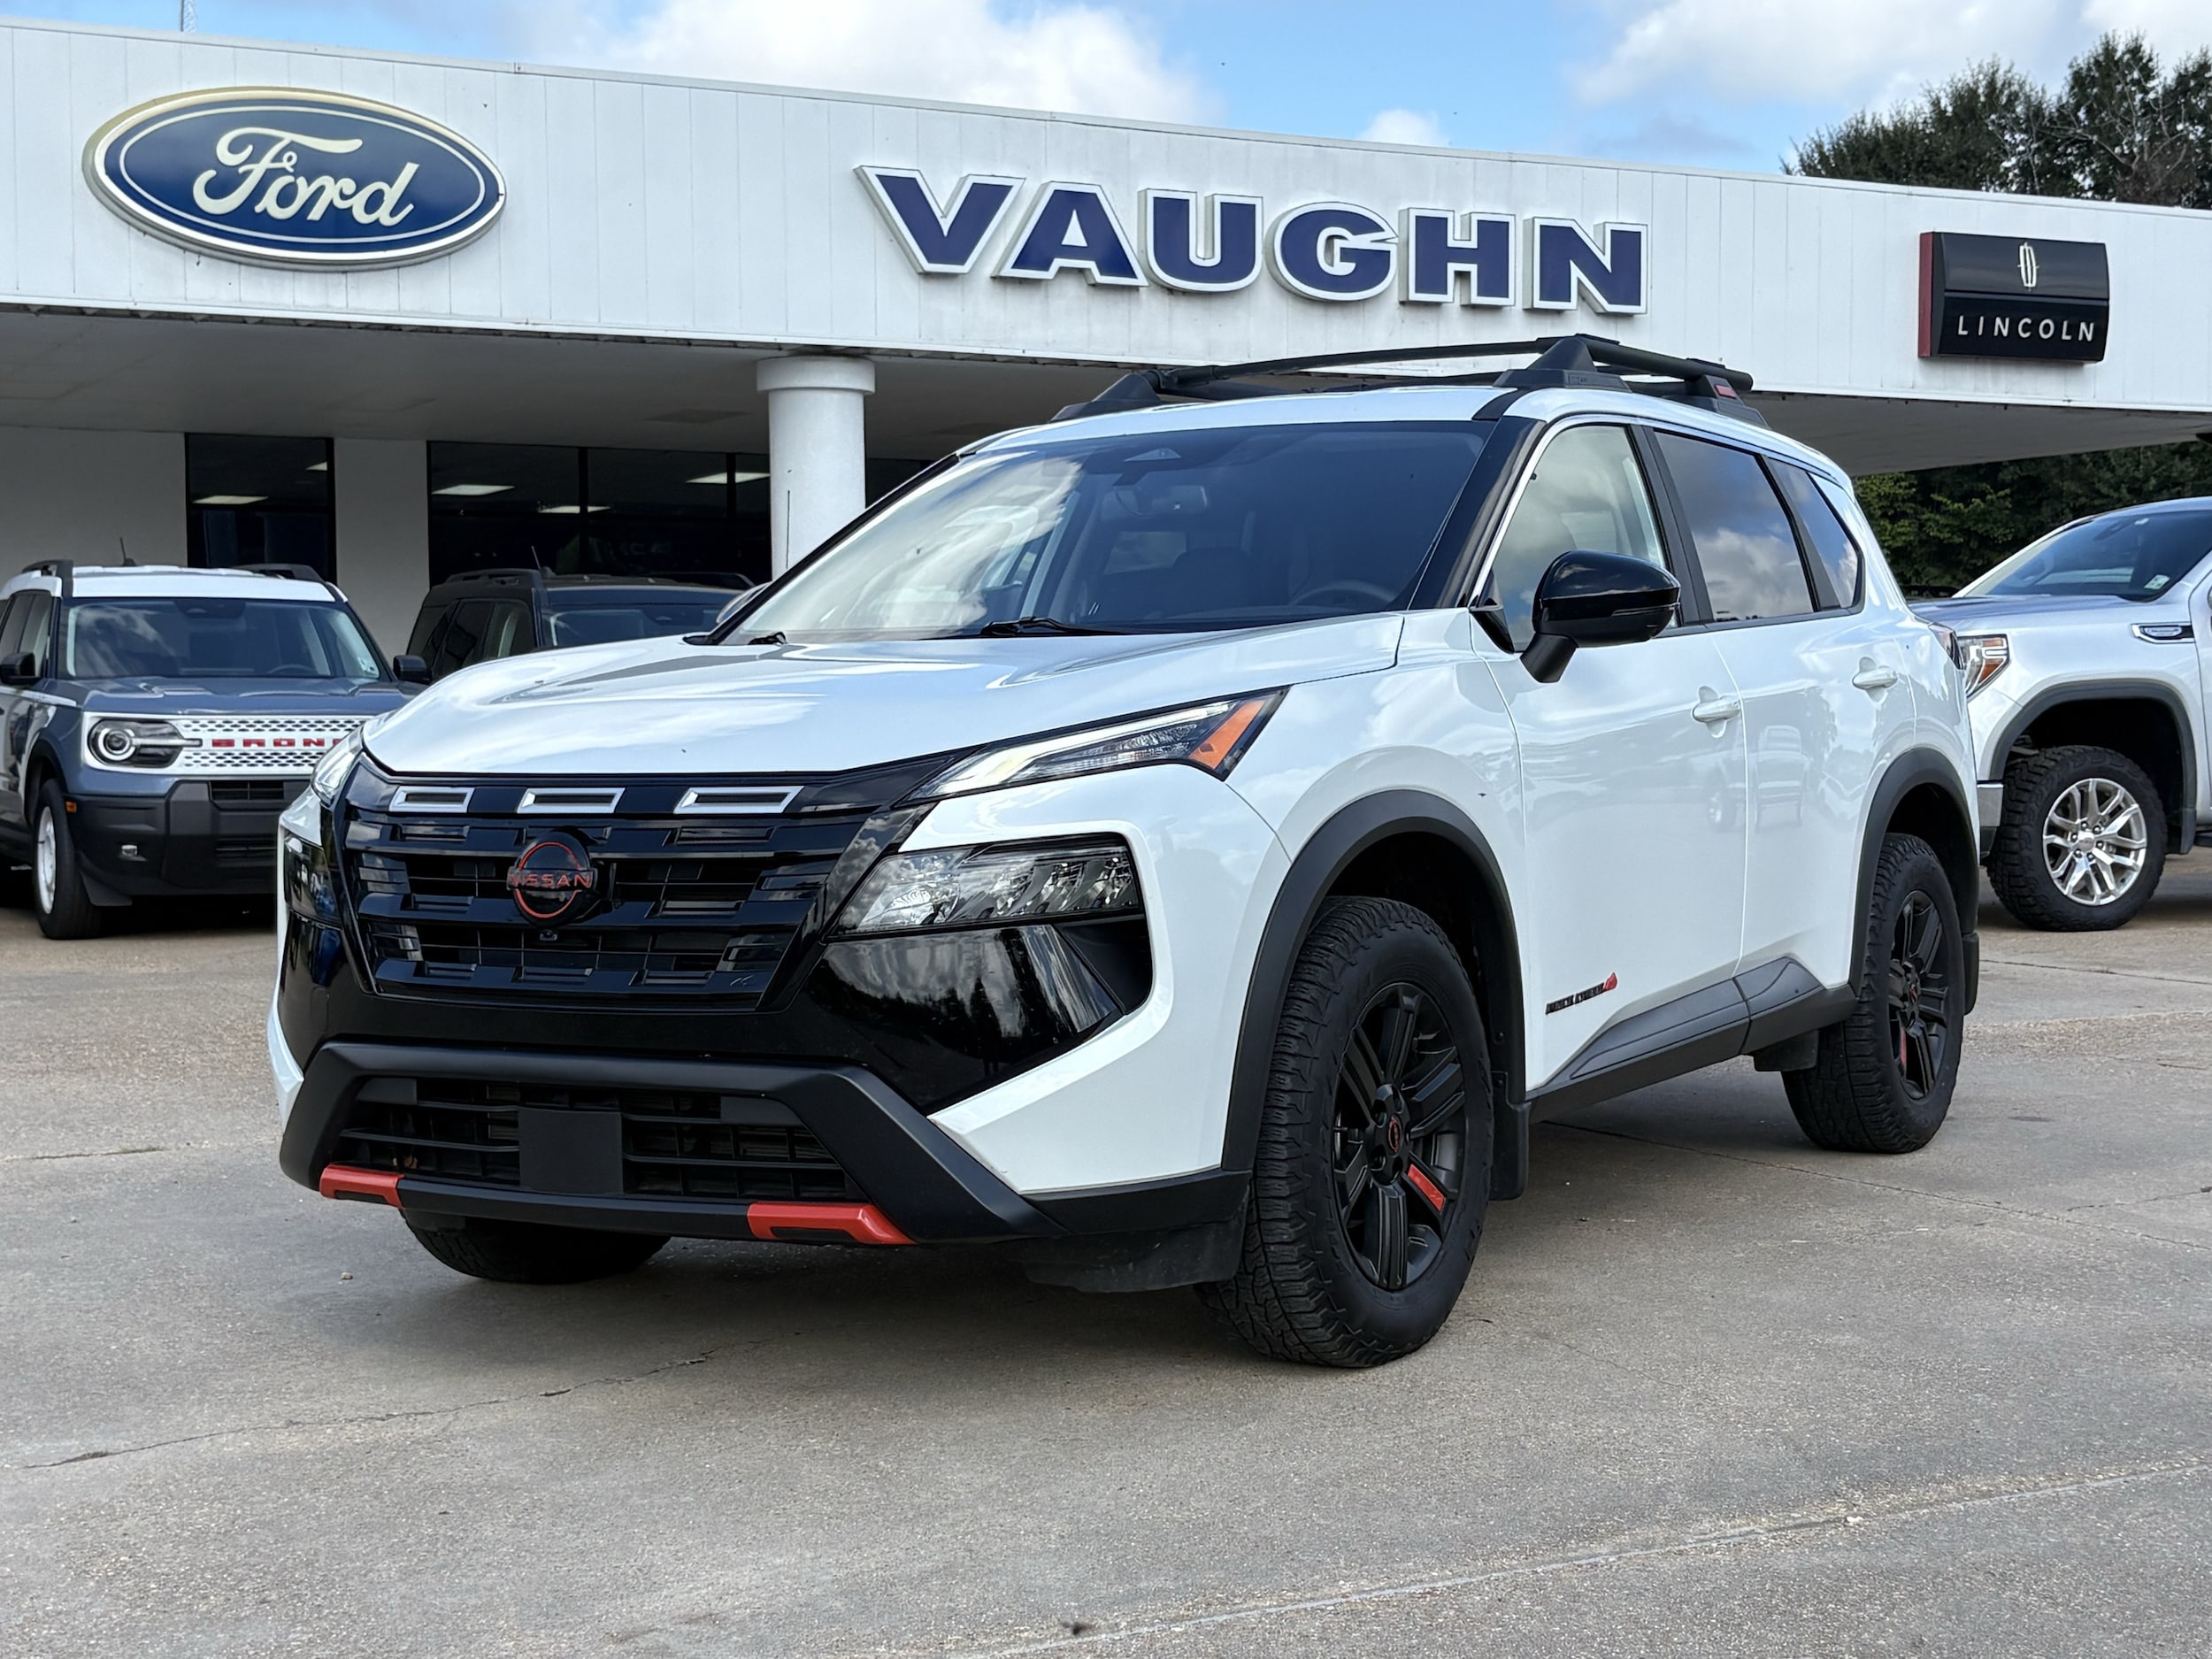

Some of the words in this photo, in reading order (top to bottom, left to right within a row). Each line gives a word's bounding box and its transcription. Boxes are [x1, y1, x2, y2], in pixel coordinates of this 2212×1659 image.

[193, 127, 419, 227] Ford
[854, 165, 1648, 314] VAUGHN
[1957, 315, 2094, 342] LINCOLN
[509, 873, 592, 888] NISSAN
